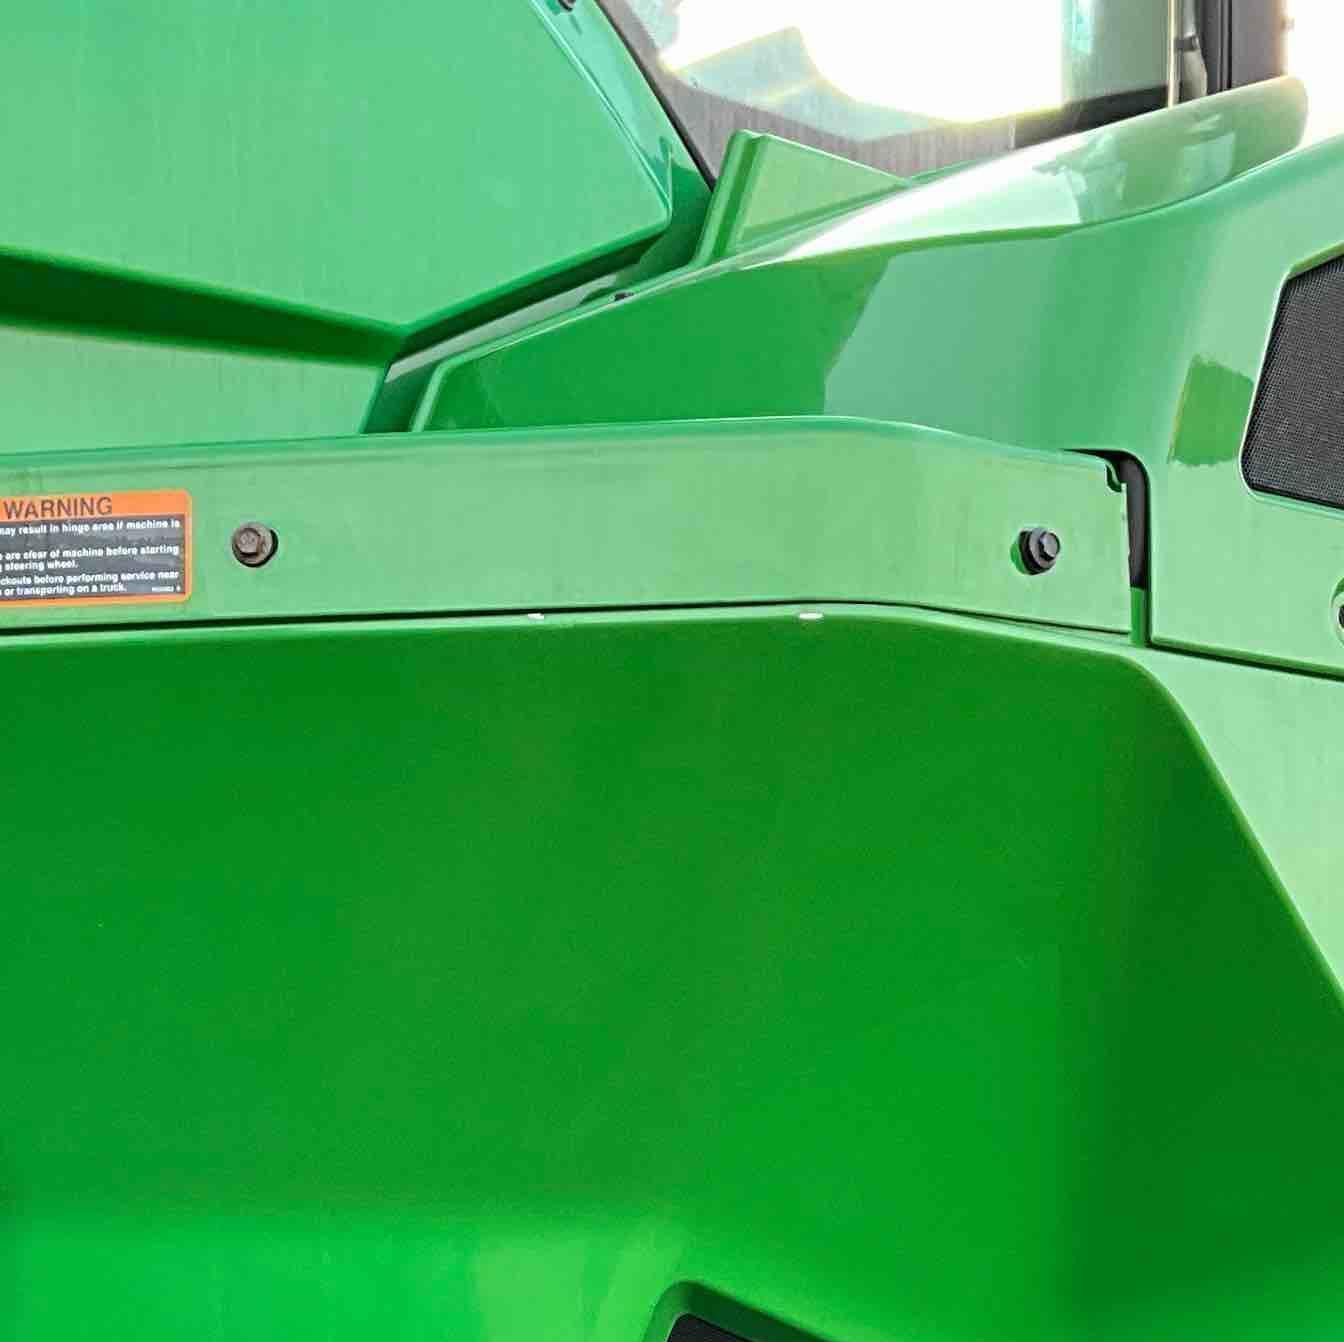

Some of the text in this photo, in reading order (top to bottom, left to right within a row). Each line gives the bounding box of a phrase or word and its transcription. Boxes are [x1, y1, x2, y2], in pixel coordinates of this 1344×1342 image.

[3, 496, 112, 519] WARNING
[19, 524, 47, 535] result
[50, 523, 60, 532] in
[62, 522, 90, 534] hinge
[92, 522, 115, 531] area
[126, 519, 168, 529] machine
[5, 551, 22, 560] are
[23, 550, 47, 560] clear
[50, 548, 60, 558] of
[62, 547, 104, 557] machine
[106, 546, 138, 556] before
[140, 544, 180, 556] starting
[4, 560, 45, 572] steering
[47, 559, 79, 569] wheel.
[34, 574, 64, 584] before
[66, 571, 118, 584] performing
[121, 570, 156, 580] service
[158, 569, 179, 579] near
[3, 587, 15, 596] or
[16, 584, 76, 597] transporting
[77, 584, 90, 592] on
[91, 584, 99, 592] a
[100, 582, 128, 592] truck.
